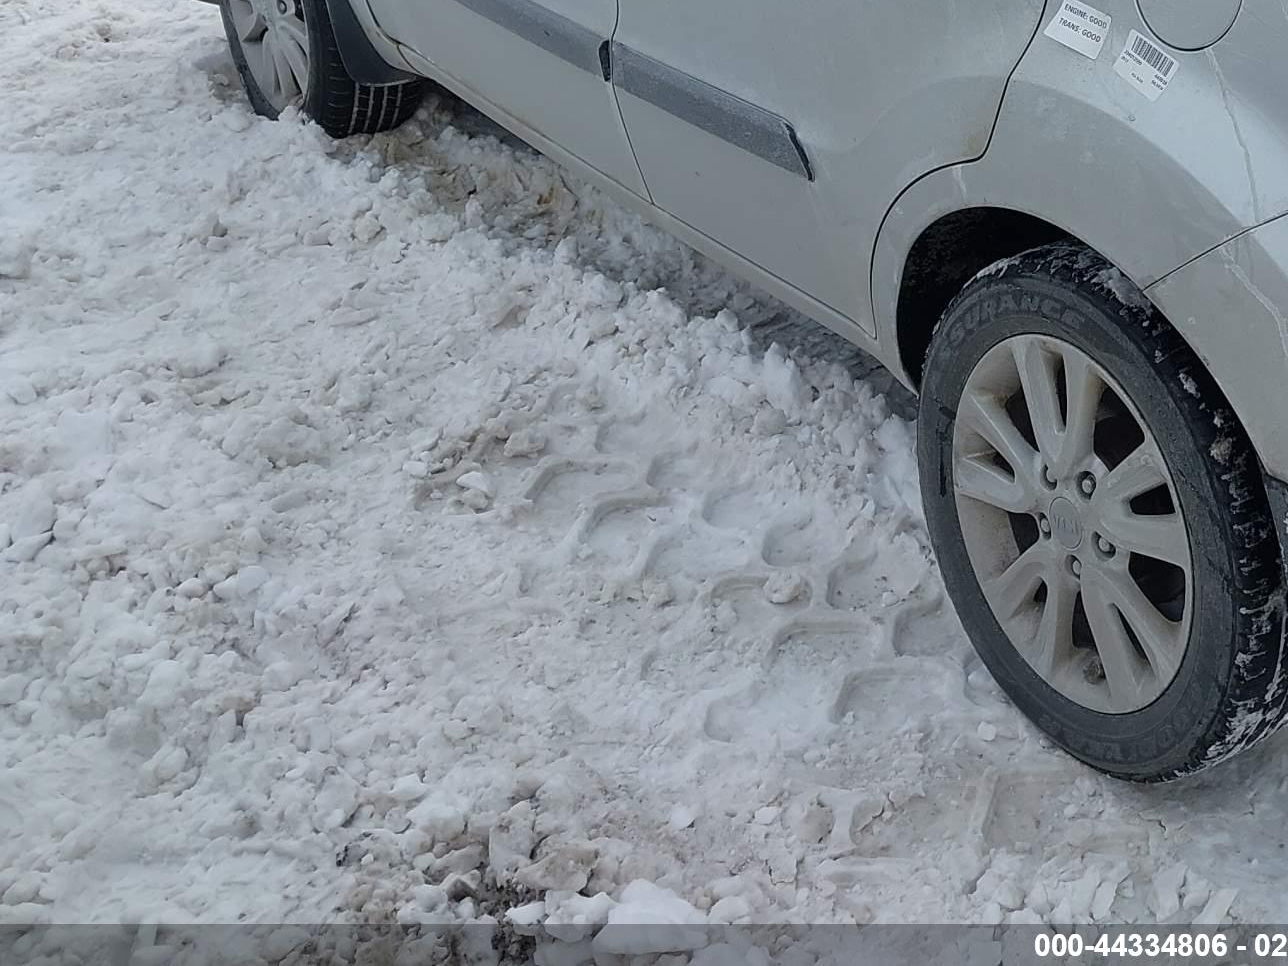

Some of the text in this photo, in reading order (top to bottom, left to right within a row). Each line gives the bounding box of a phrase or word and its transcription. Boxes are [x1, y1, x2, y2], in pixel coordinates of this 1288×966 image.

[1064, 3, 1107, 29] ENGINE: GOOD
[1059, 17, 1101, 43] TRANS: GOOD
